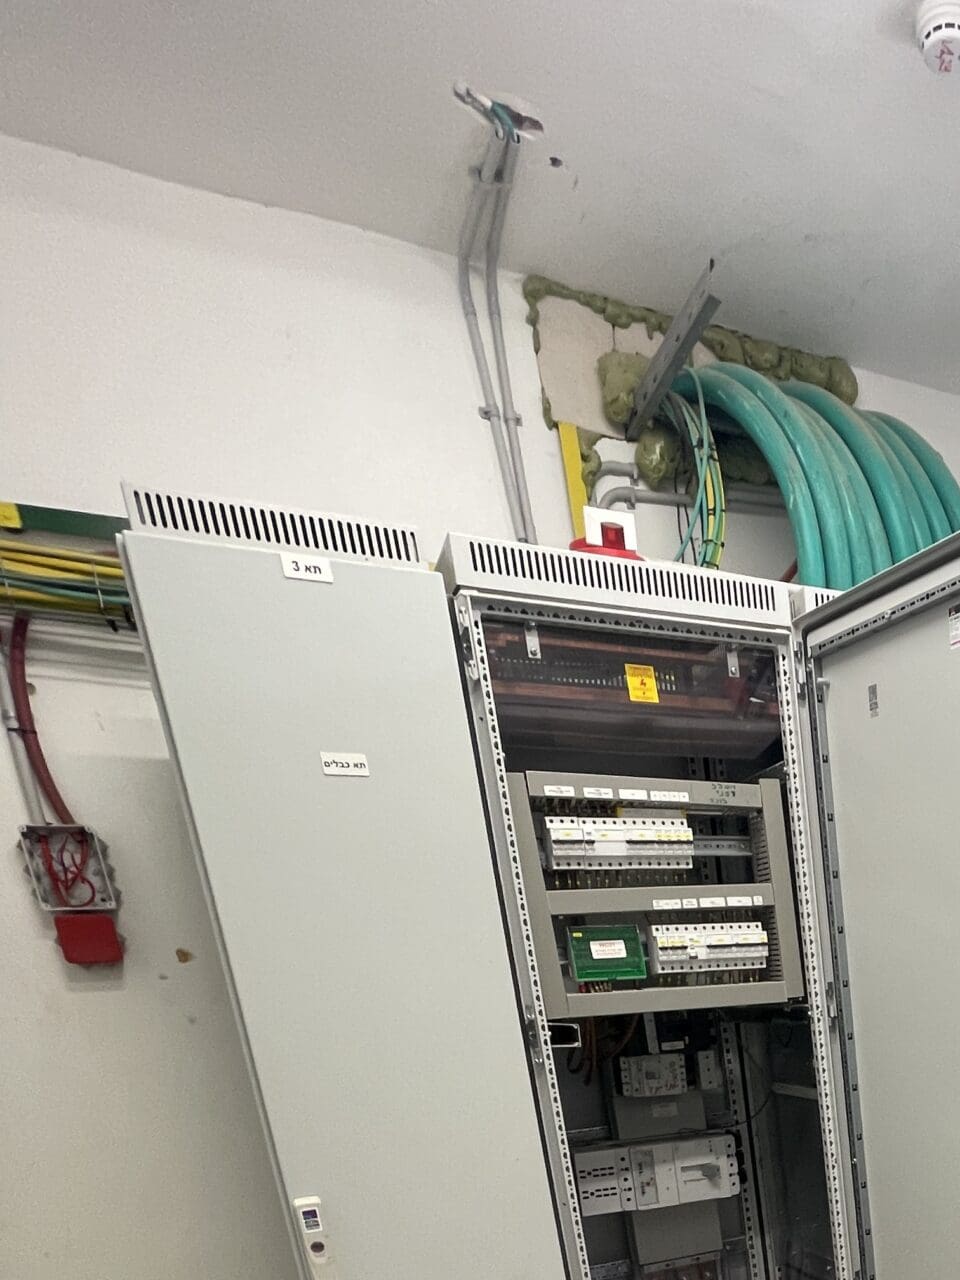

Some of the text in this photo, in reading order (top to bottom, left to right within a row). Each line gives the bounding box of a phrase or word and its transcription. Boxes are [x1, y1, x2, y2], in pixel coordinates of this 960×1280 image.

[291, 560, 322, 575] תא 3
[323, 760, 350, 768] כבלים
